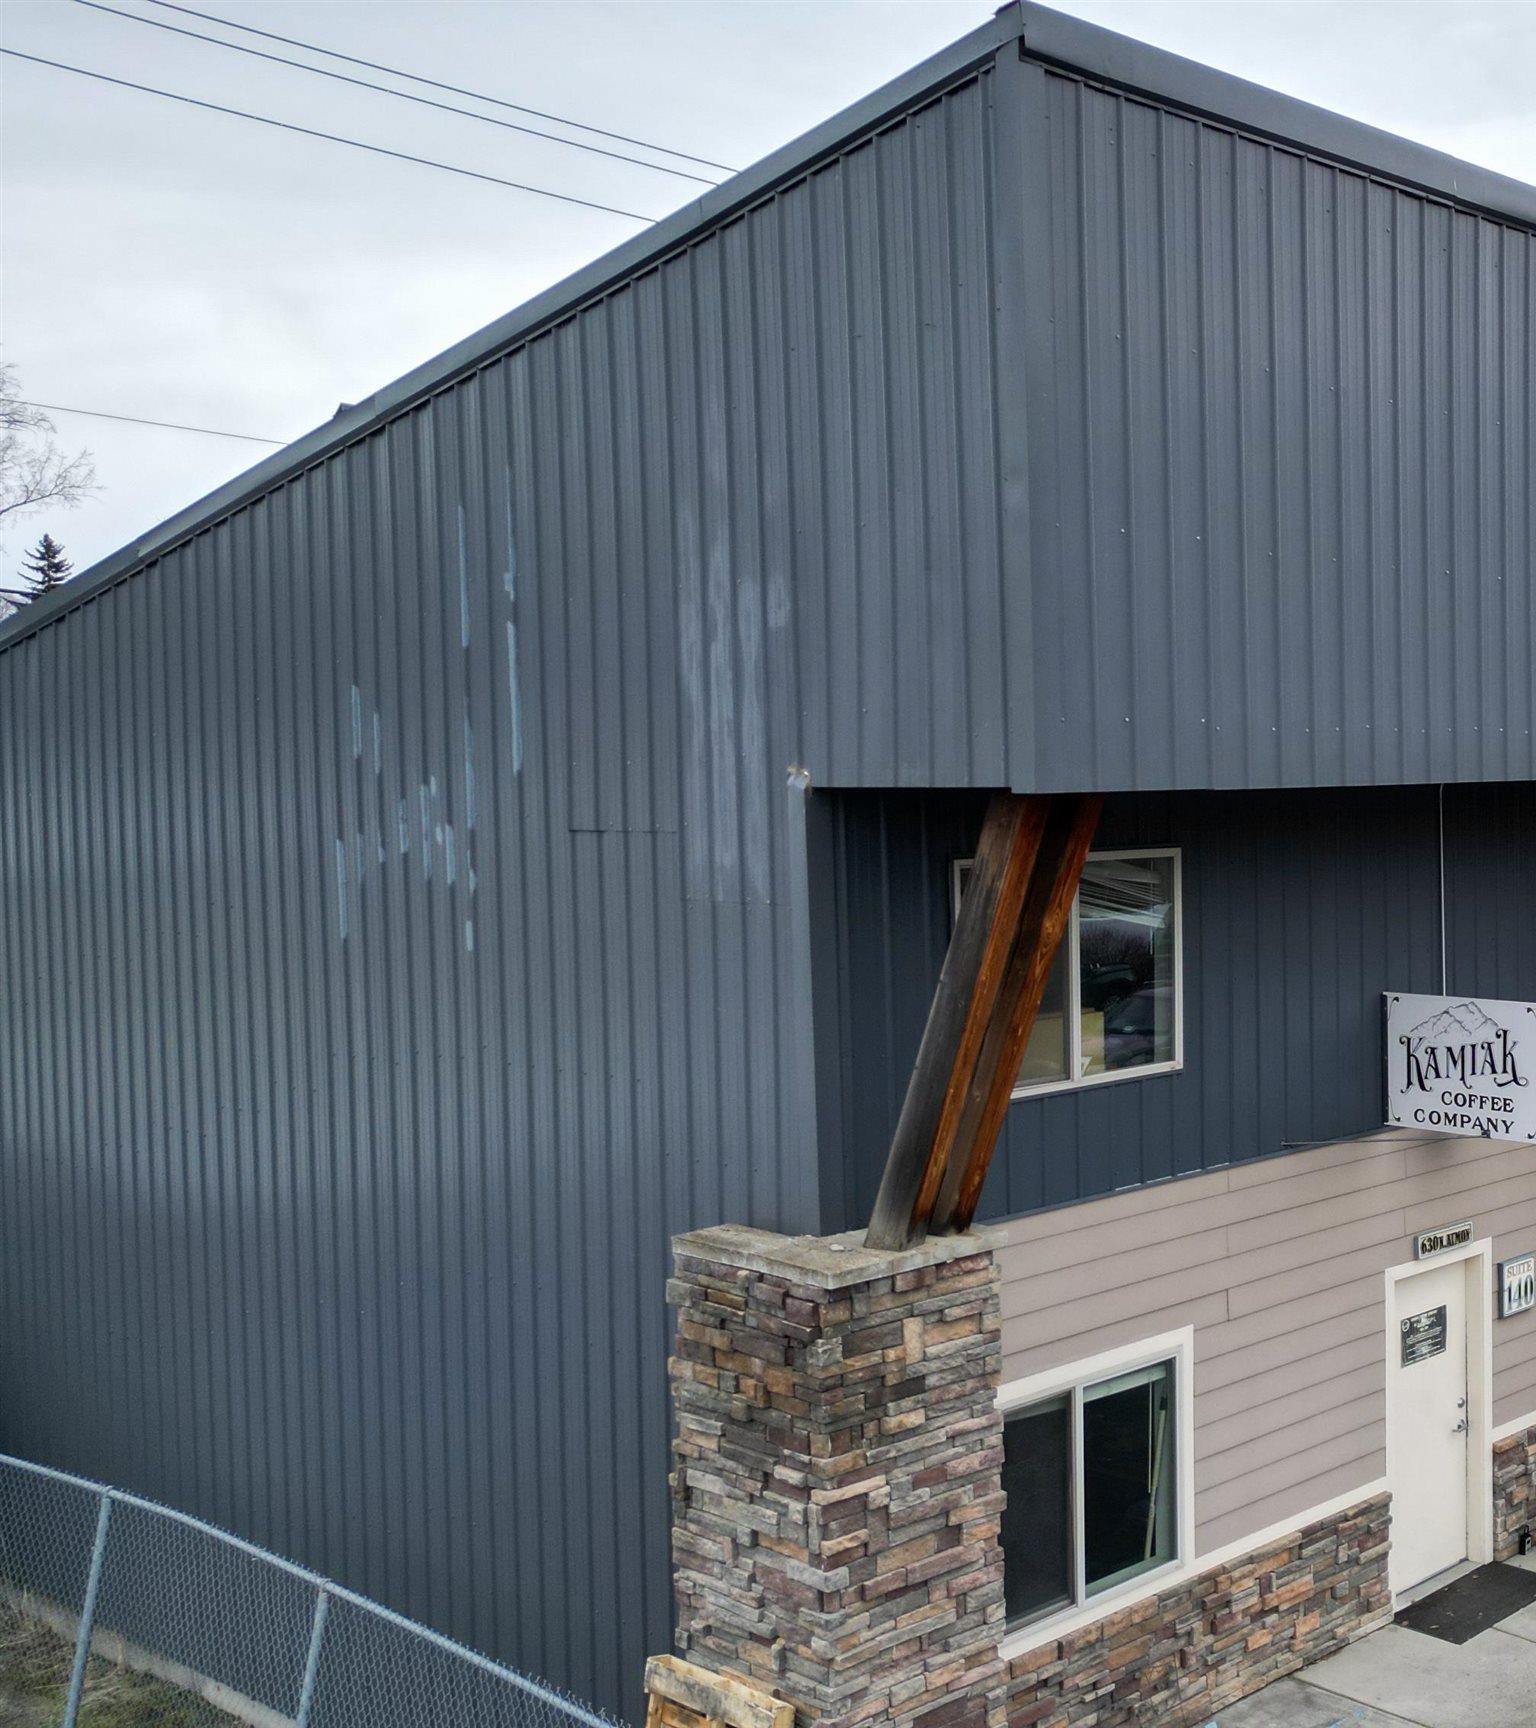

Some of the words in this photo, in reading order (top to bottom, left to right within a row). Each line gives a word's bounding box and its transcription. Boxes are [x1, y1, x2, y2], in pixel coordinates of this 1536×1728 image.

[1400, 1028, 1529, 1094] KAMIAK
[1441, 1090, 1515, 1113] COFFEE
[1413, 1108, 1516, 1134] COMPANY
[1421, 1235, 1439, 1255] 630
[1507, 1261, 1533, 1279] SUITE
[1507, 1274, 1534, 1311] 140
